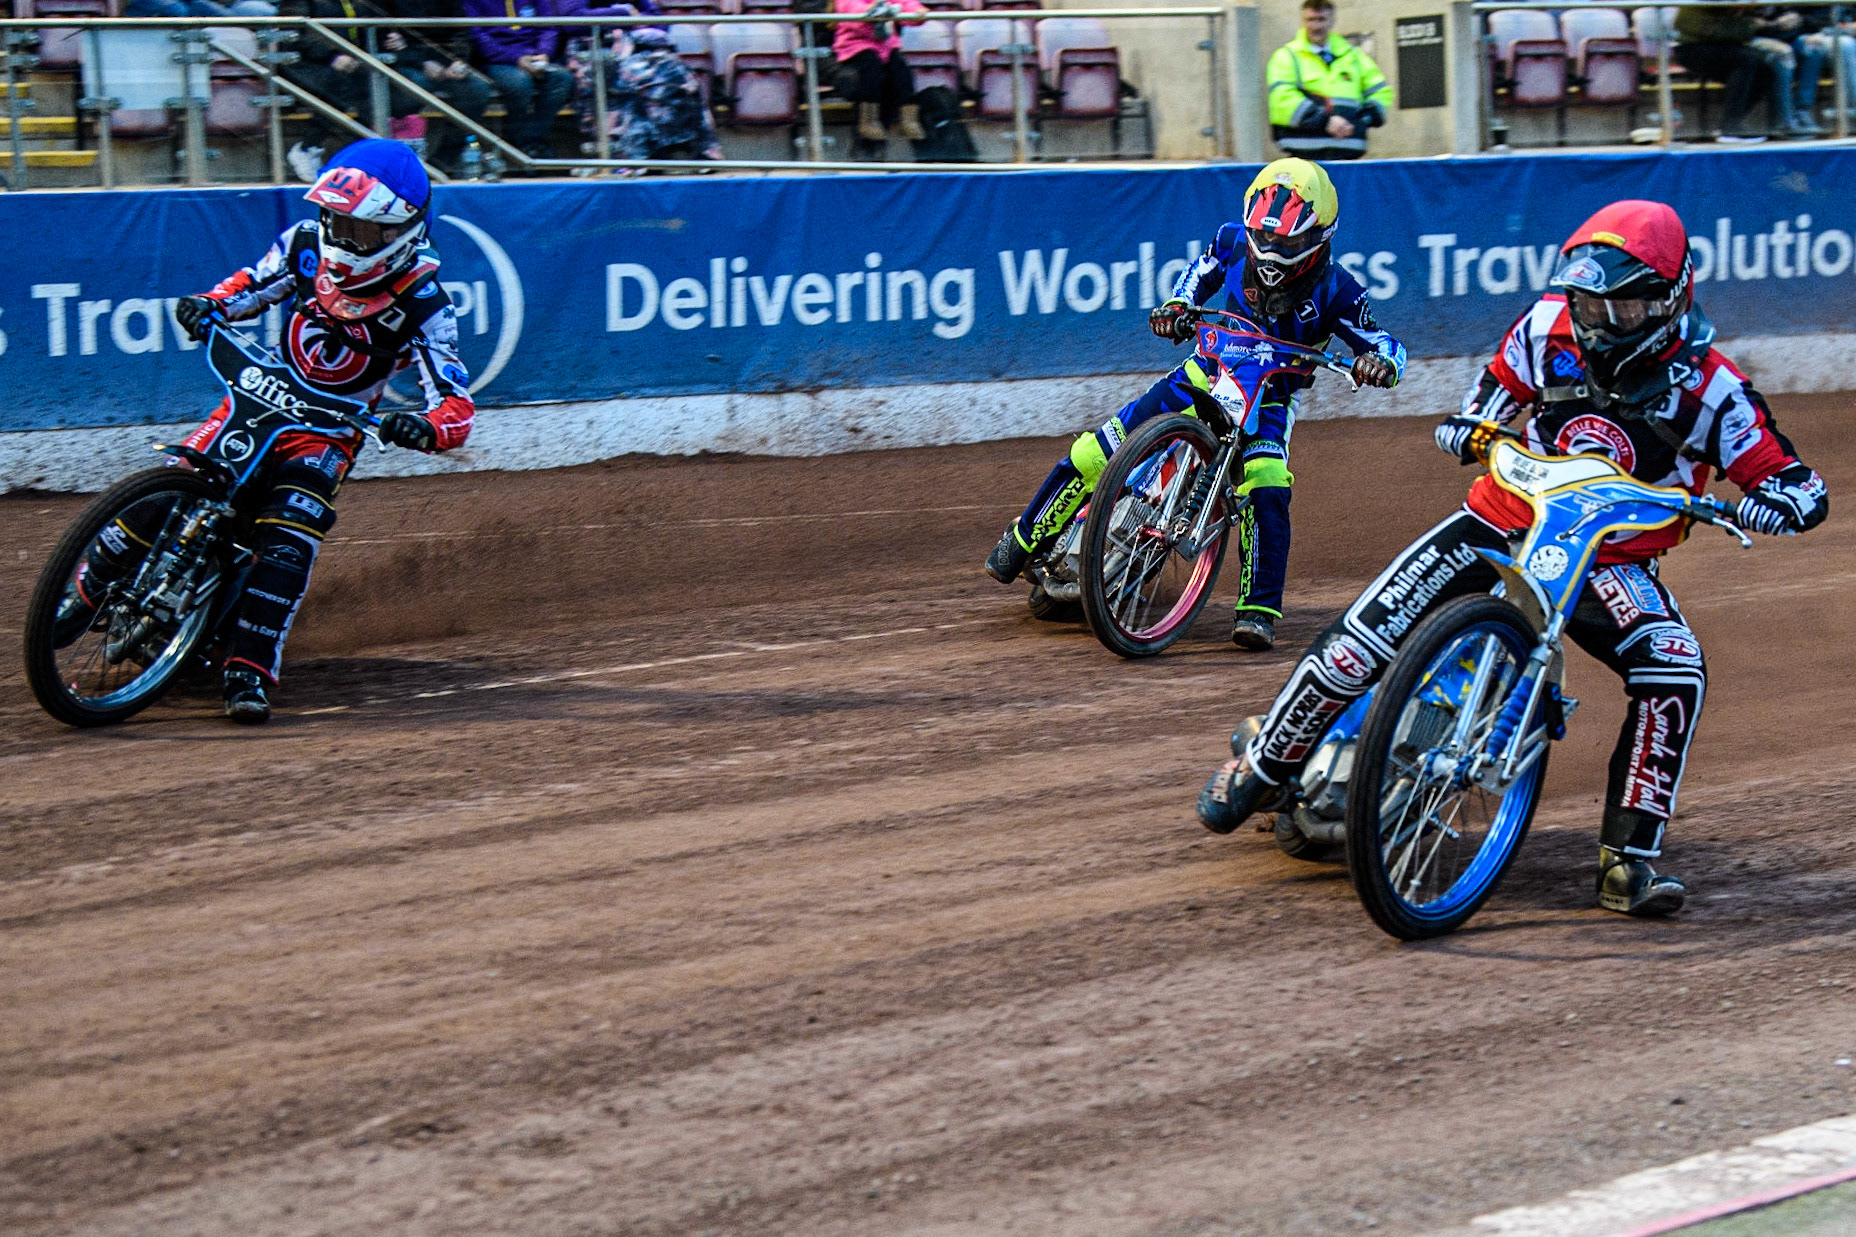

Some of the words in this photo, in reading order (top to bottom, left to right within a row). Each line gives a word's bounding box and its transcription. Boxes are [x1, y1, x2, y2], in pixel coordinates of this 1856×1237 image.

[606, 251, 976, 340] Delivering
[1418, 233, 1559, 297] Trav
[1688, 213, 1856, 283] olutio
[239, 366, 309, 417] Office
[1566, 420, 1592, 438] BELLE
[1375, 563, 1456, 644] Fabrications
[1443, 542, 1478, 571] Ltd
[1377, 544, 1441, 611] Philmar
[1330, 642, 1367, 678] STS
[1653, 638, 1699, 655] STS
[1266, 725, 1297, 759] JACK
[1650, 696, 1686, 759] Sarah
[1620, 775, 1636, 808] MEDIA
[1634, 764, 1673, 819] Hall
